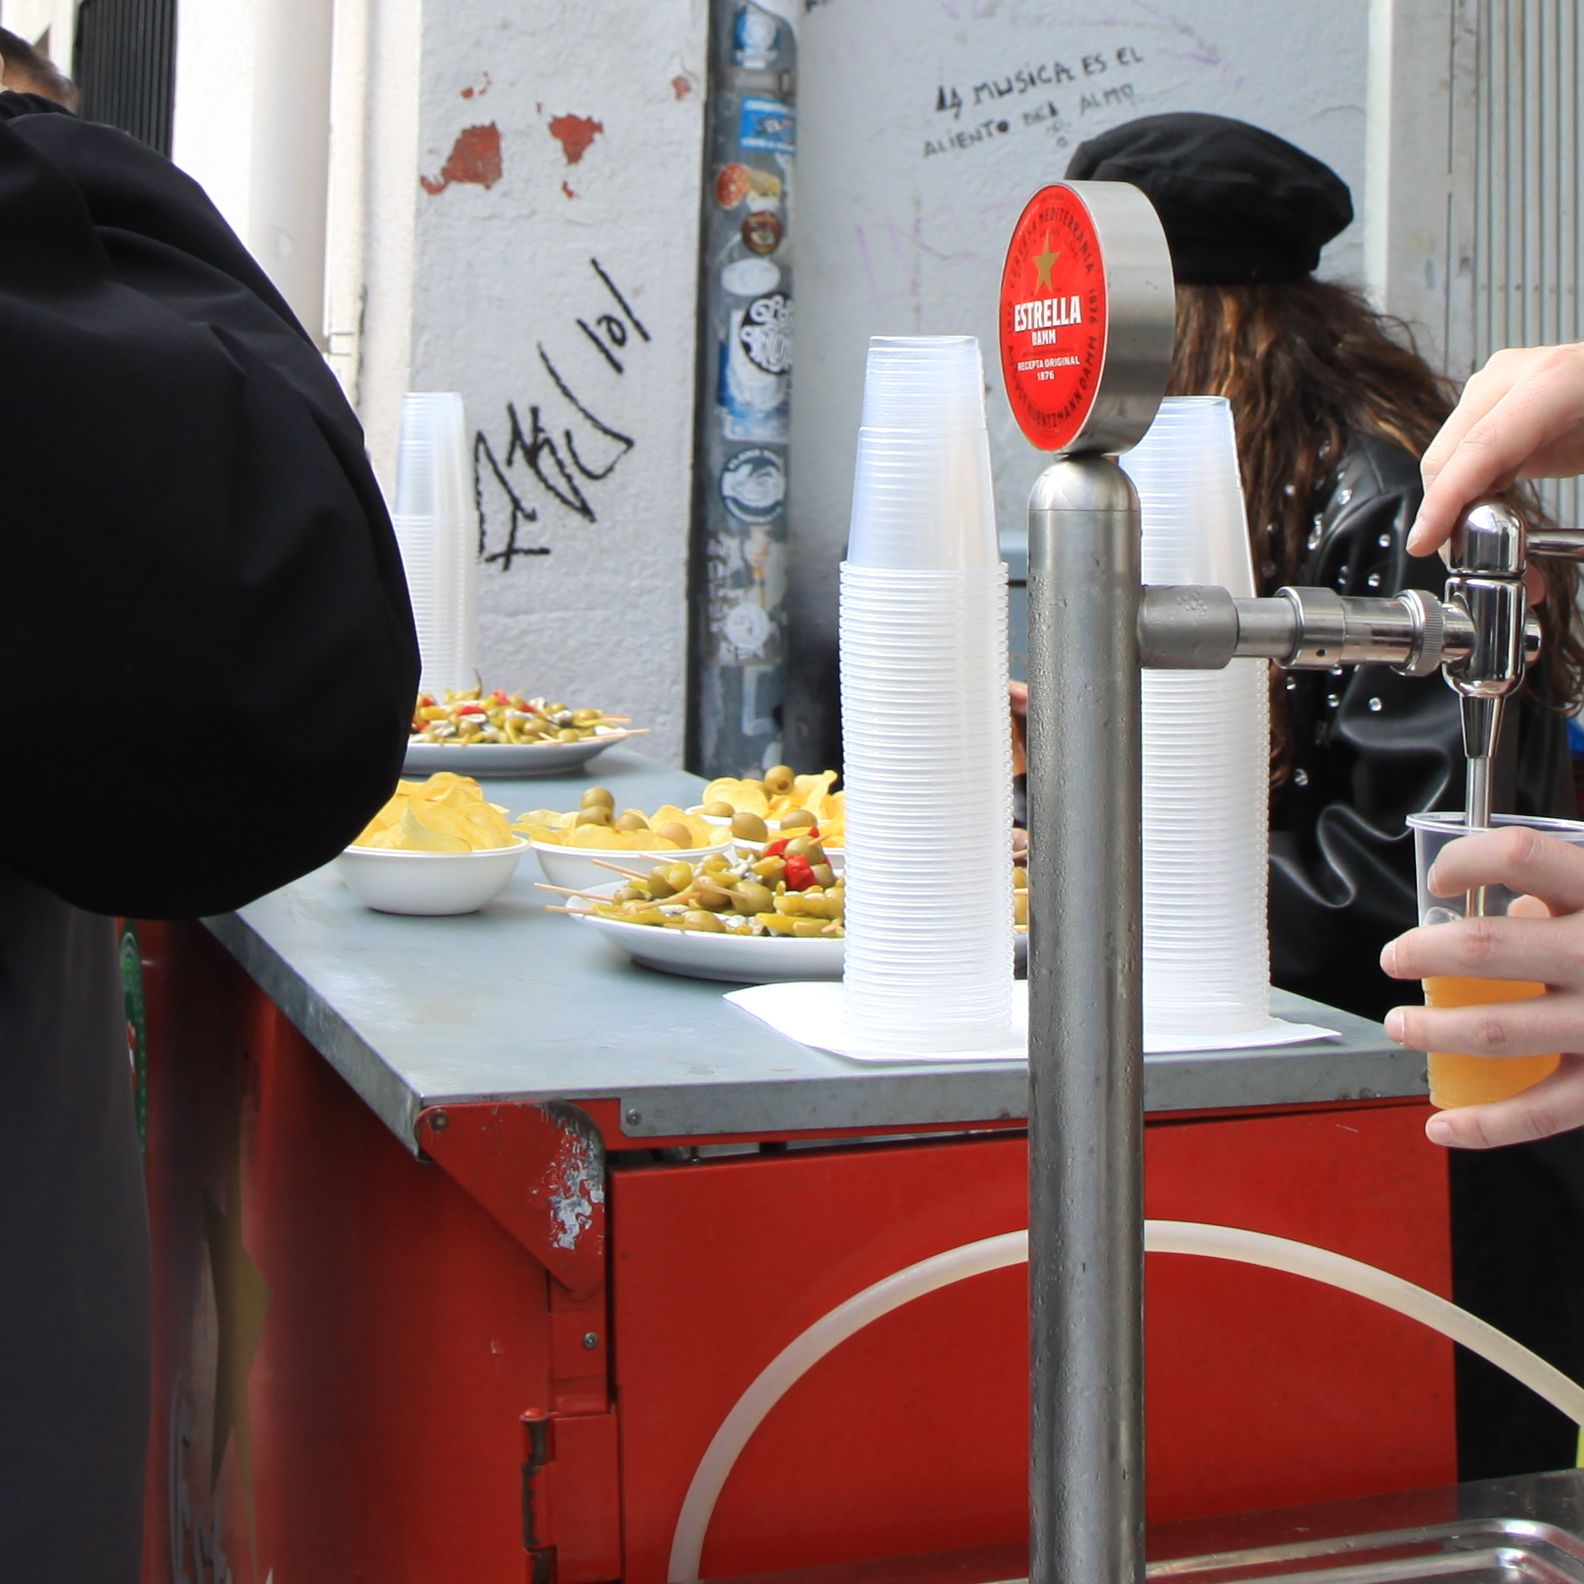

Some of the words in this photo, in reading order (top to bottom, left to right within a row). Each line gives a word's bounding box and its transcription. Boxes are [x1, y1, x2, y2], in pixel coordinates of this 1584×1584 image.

[1081, 53, 1107, 76] ES
[1014, 295, 1082, 333] ESTRELLA
[1031, 328, 1057, 347] DAMM
[1018, 359, 1044, 371] RECEPTA
[1044, 355, 1080, 368] ORIGINAL
[1037, 370, 1056, 381] 1876
